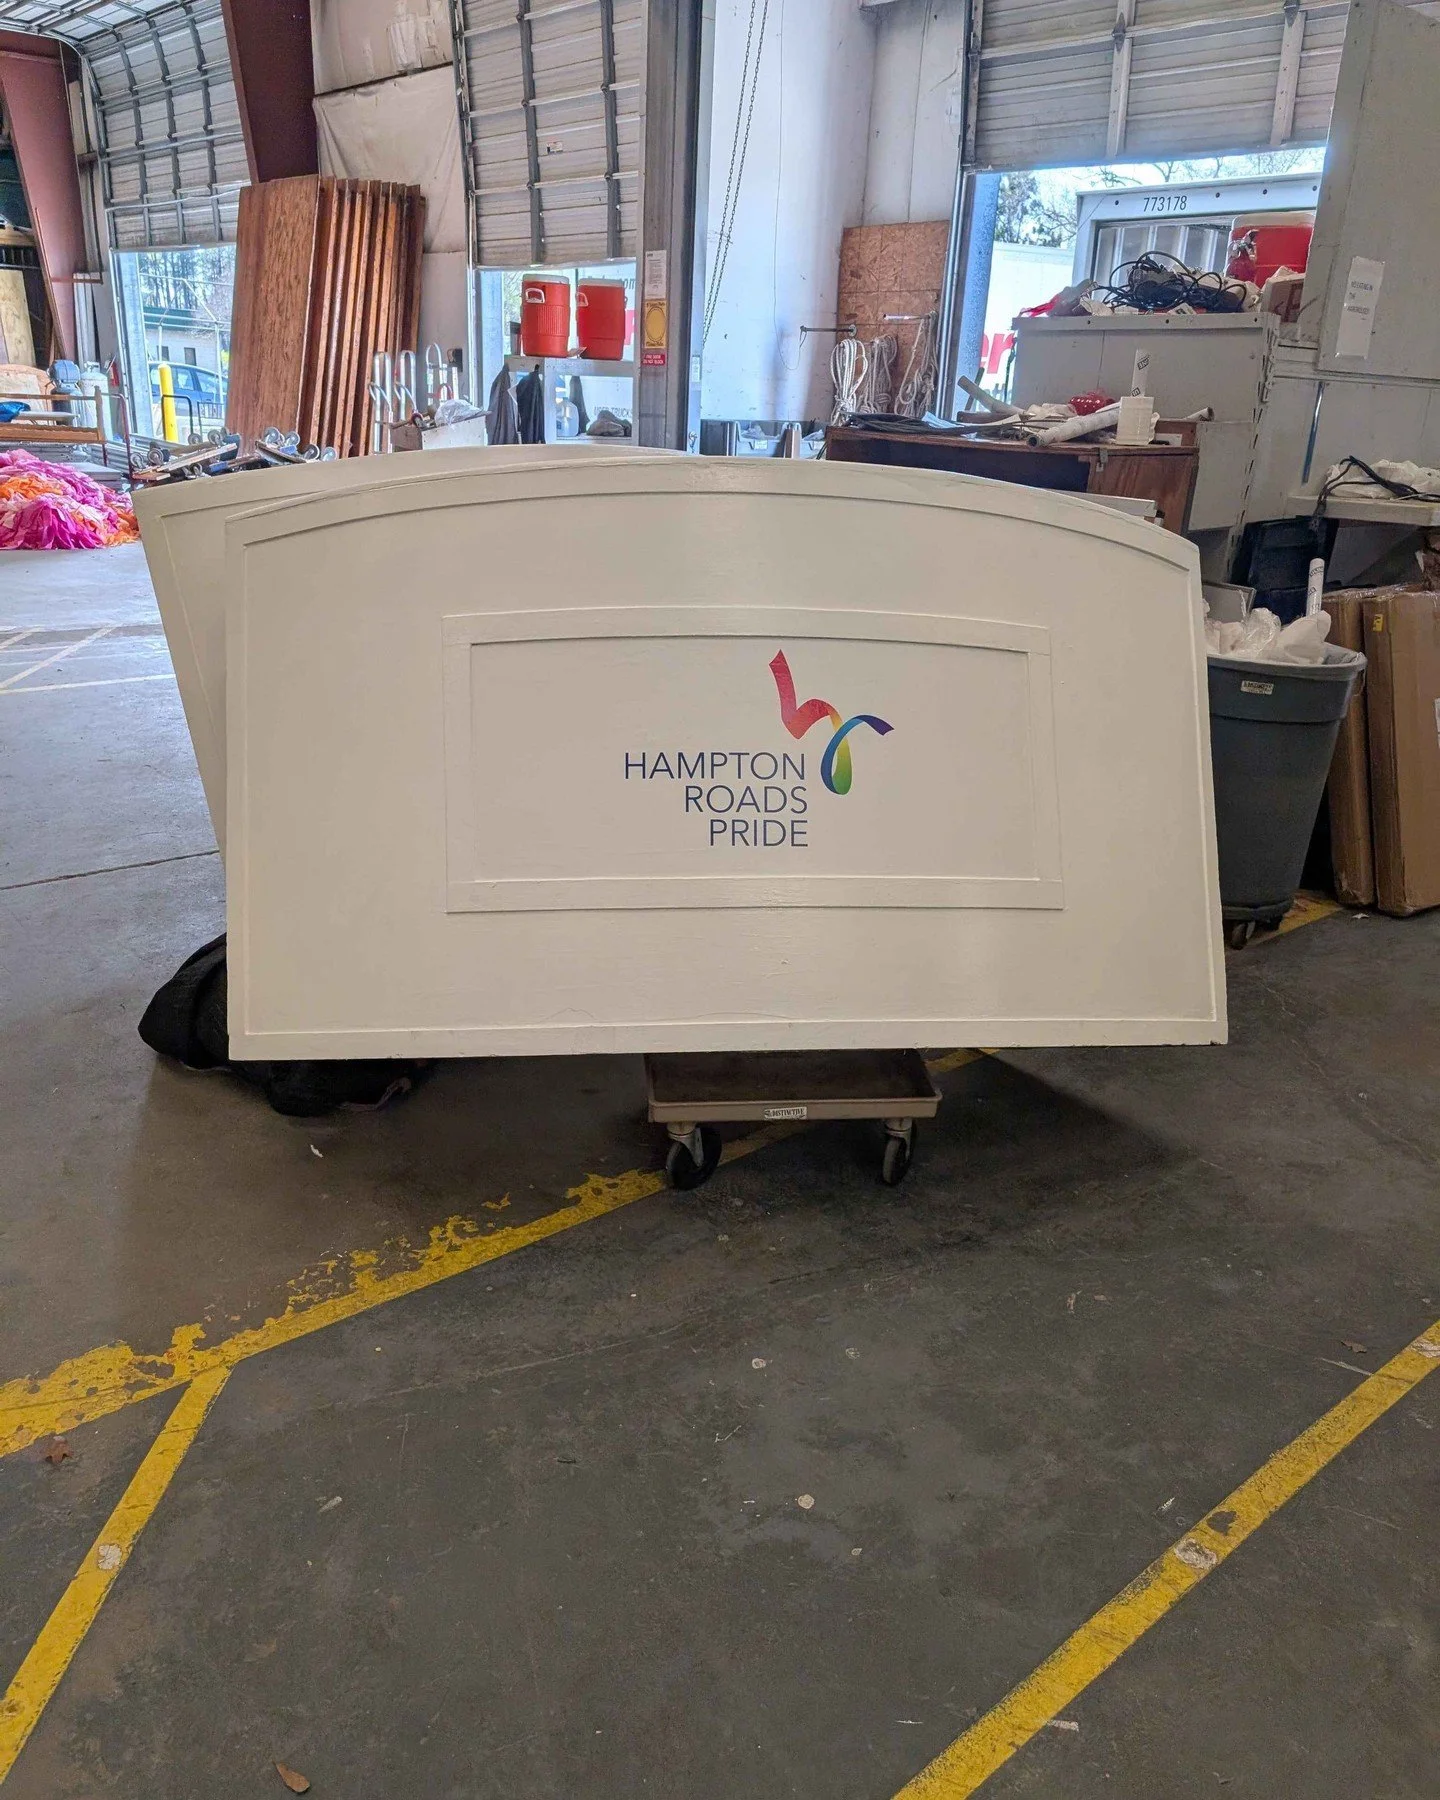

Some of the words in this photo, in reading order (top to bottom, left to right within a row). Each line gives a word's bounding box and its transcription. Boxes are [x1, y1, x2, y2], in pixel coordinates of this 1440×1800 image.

[1143, 195, 1187, 212] 773178
[624, 752, 805, 780] HAMPTON
[685, 785, 808, 814] ROADS
[710, 819, 809, 847] PRIDE
